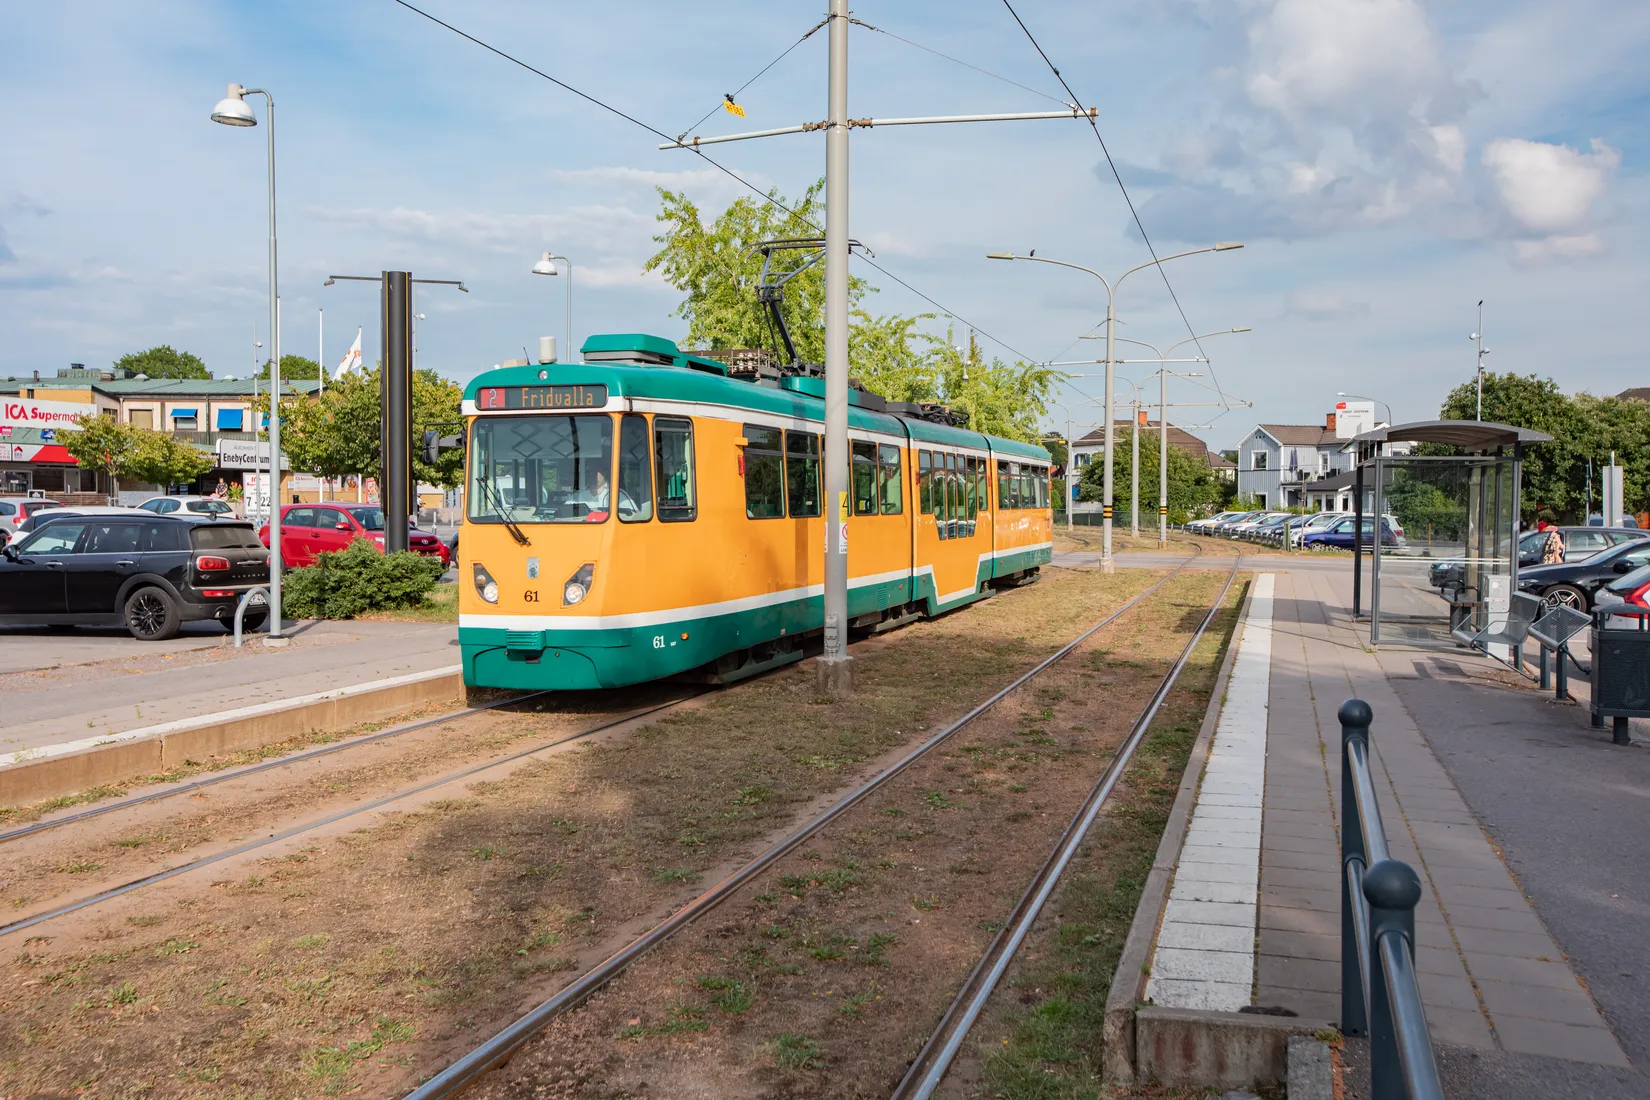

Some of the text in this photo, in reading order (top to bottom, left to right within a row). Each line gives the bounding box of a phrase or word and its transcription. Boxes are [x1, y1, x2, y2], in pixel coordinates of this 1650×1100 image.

[488, 386, 593, 408] 2 Fridvalla
[5, 404, 28, 420] ICA
[223, 453, 270, 465] EnebyCentum
[246, 496, 252, 507] 7
[524, 590, 540, 603] 61
[653, 635, 666, 649] 61
